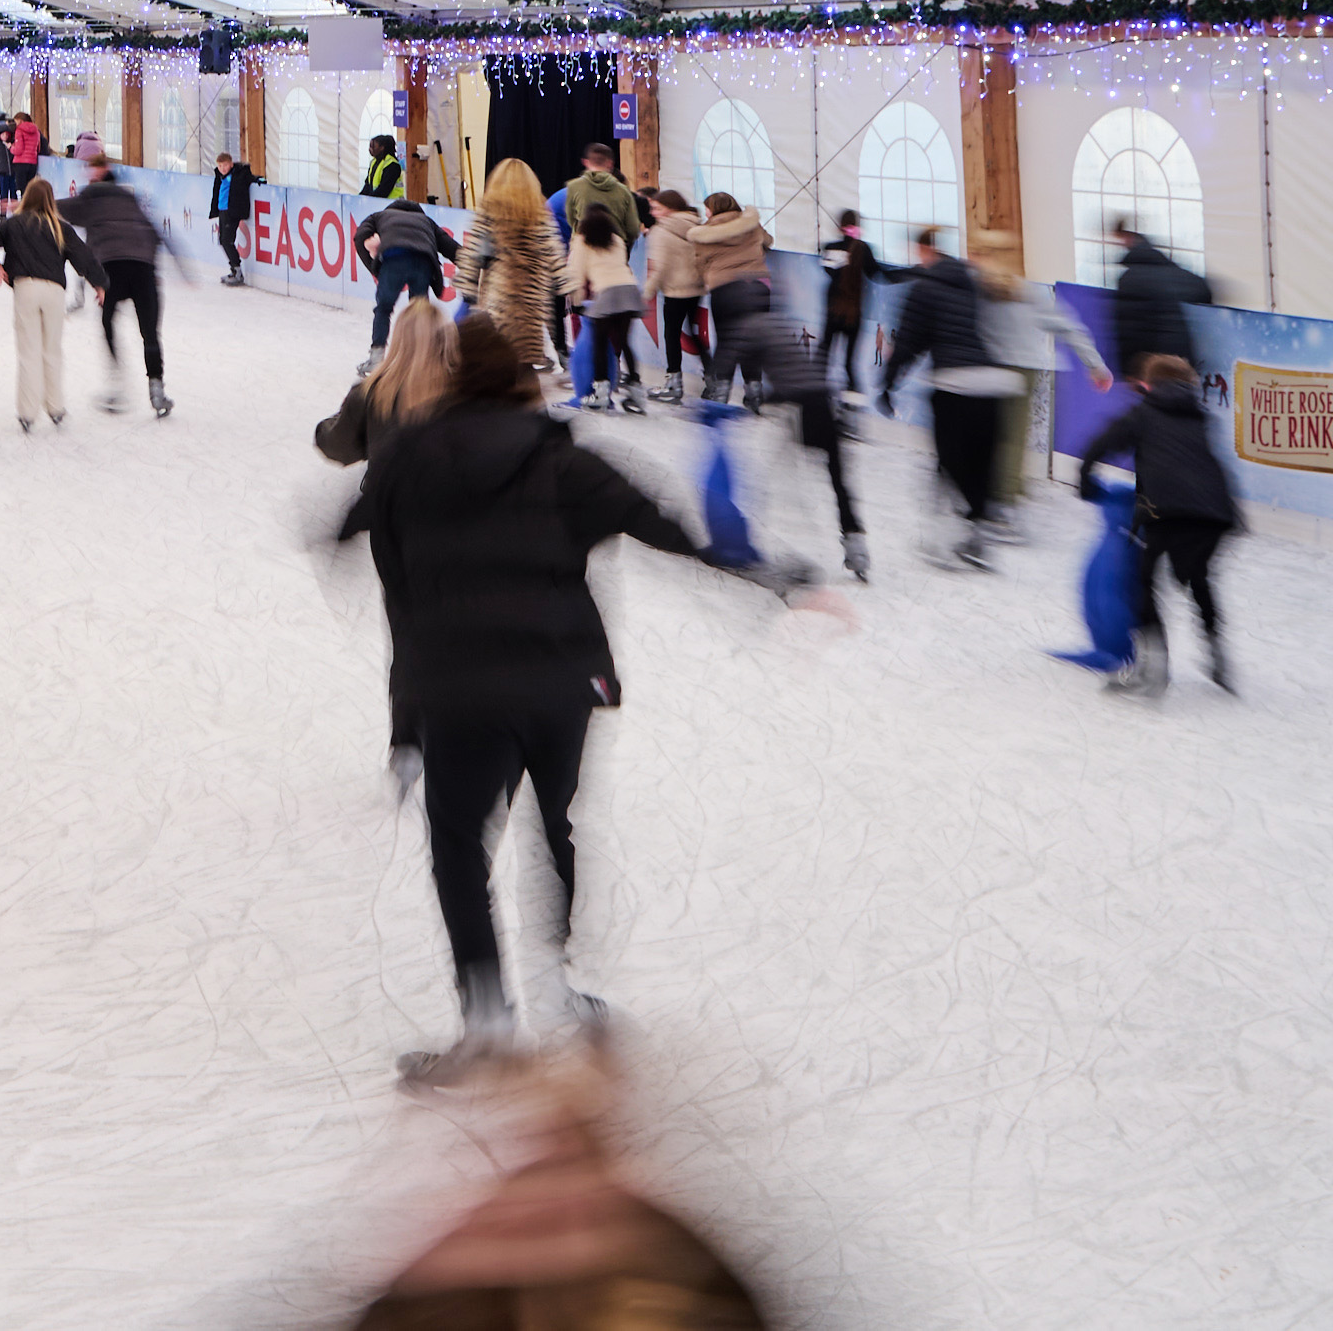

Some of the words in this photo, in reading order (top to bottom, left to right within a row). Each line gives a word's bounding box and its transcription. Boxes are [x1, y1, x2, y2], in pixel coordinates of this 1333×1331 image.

[1251, 387, 1294, 414] WHITE
[1299, 391, 1333, 414] ROSE
[1251, 413, 1281, 448] ICE
[1288, 415, 1333, 449] RINK
